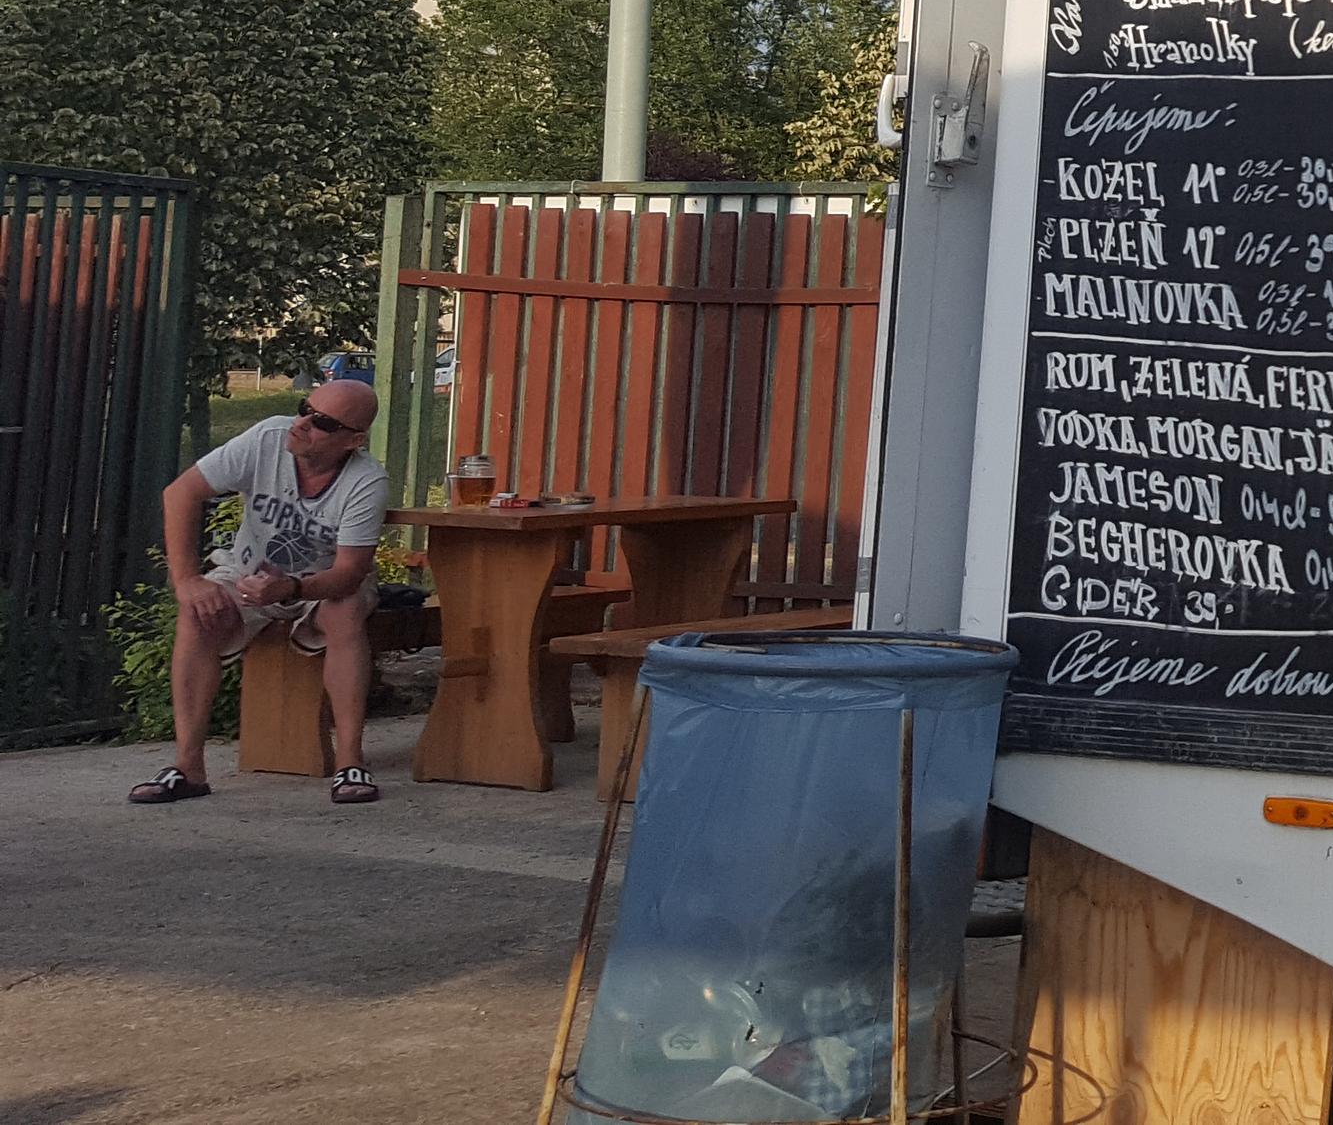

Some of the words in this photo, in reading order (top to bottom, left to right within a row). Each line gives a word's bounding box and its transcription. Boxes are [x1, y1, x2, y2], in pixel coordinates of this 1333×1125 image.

[1122, 16, 1258, 76] Hranolky
[1058, 157, 1165, 207] KOZEL
[1060, 208, 1168, 271] PLZEŇ
[1043, 272, 1248, 331] MALINOVKA
[1049, 461, 1223, 525] JAMESON
[1041, 564, 1160, 621] CIDER
[1046, 629, 1219, 697] Přejeme
